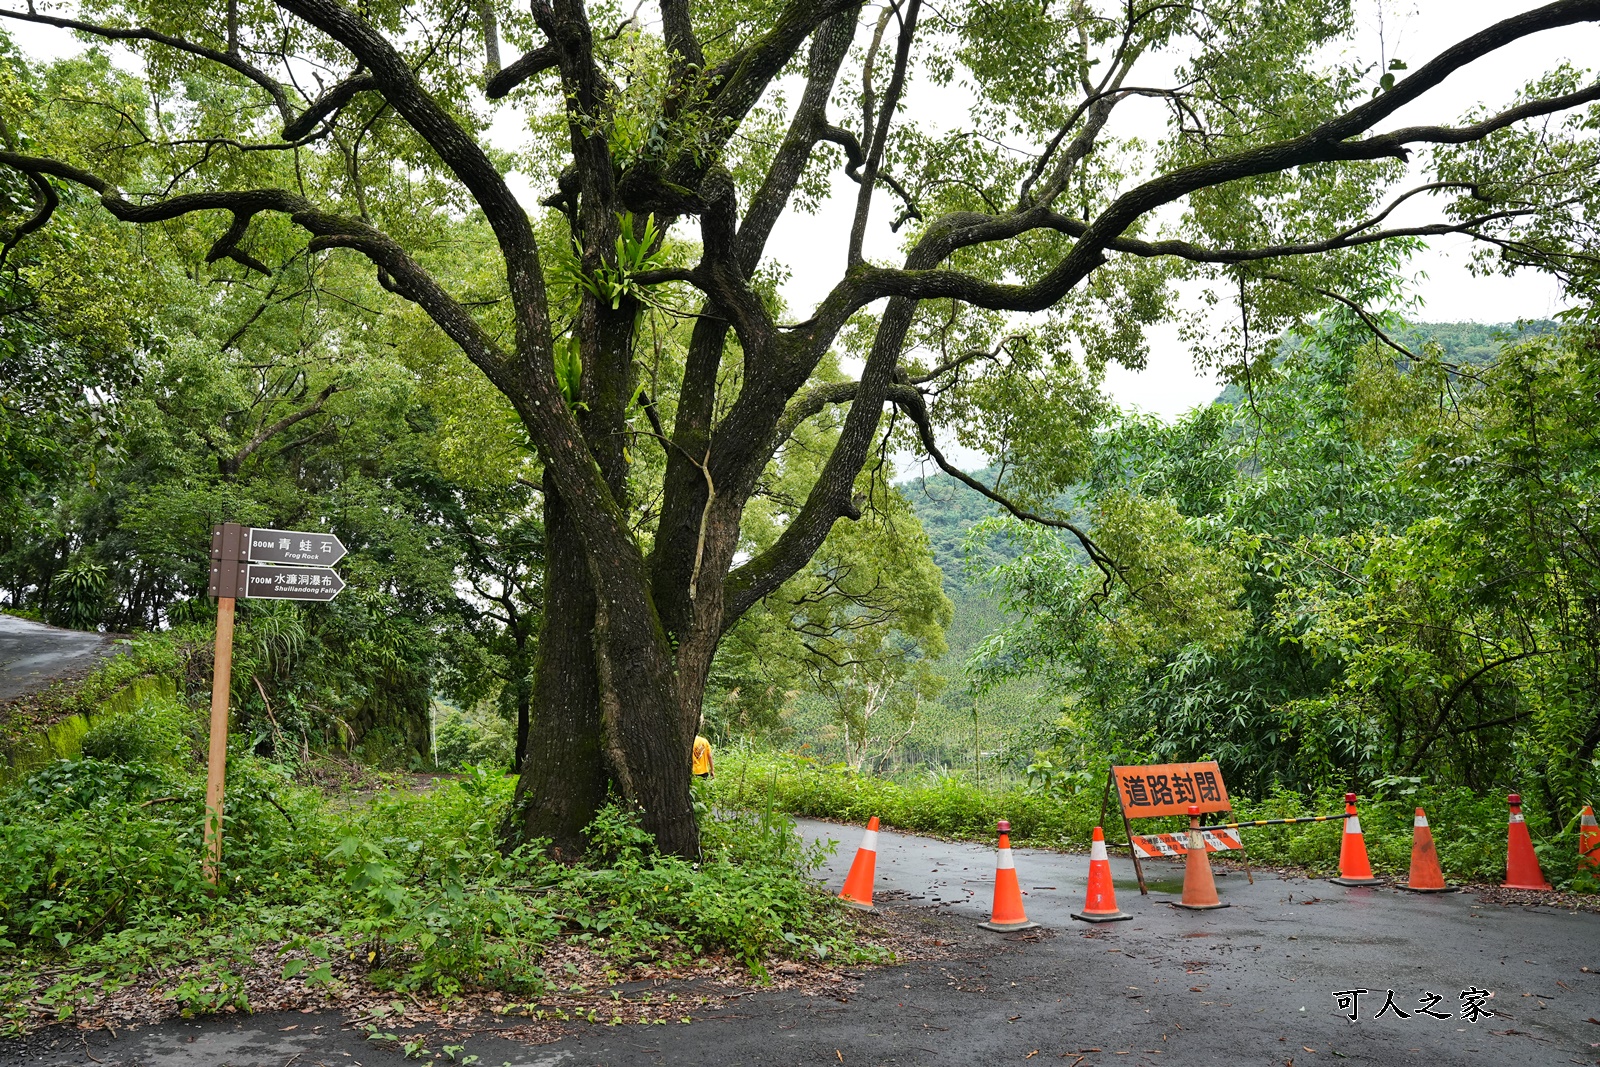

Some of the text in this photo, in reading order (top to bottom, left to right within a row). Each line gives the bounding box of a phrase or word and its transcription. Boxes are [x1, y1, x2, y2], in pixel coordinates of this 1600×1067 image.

[253, 538, 333, 553] 800M 青蛙石
[284, 552, 319, 560] Frog Rock
[250, 573, 333, 587] 700M 水濂洞瀑布
[274, 585, 319, 594] Shuiliandong
[1122, 771, 1221, 807] 道路封閉
